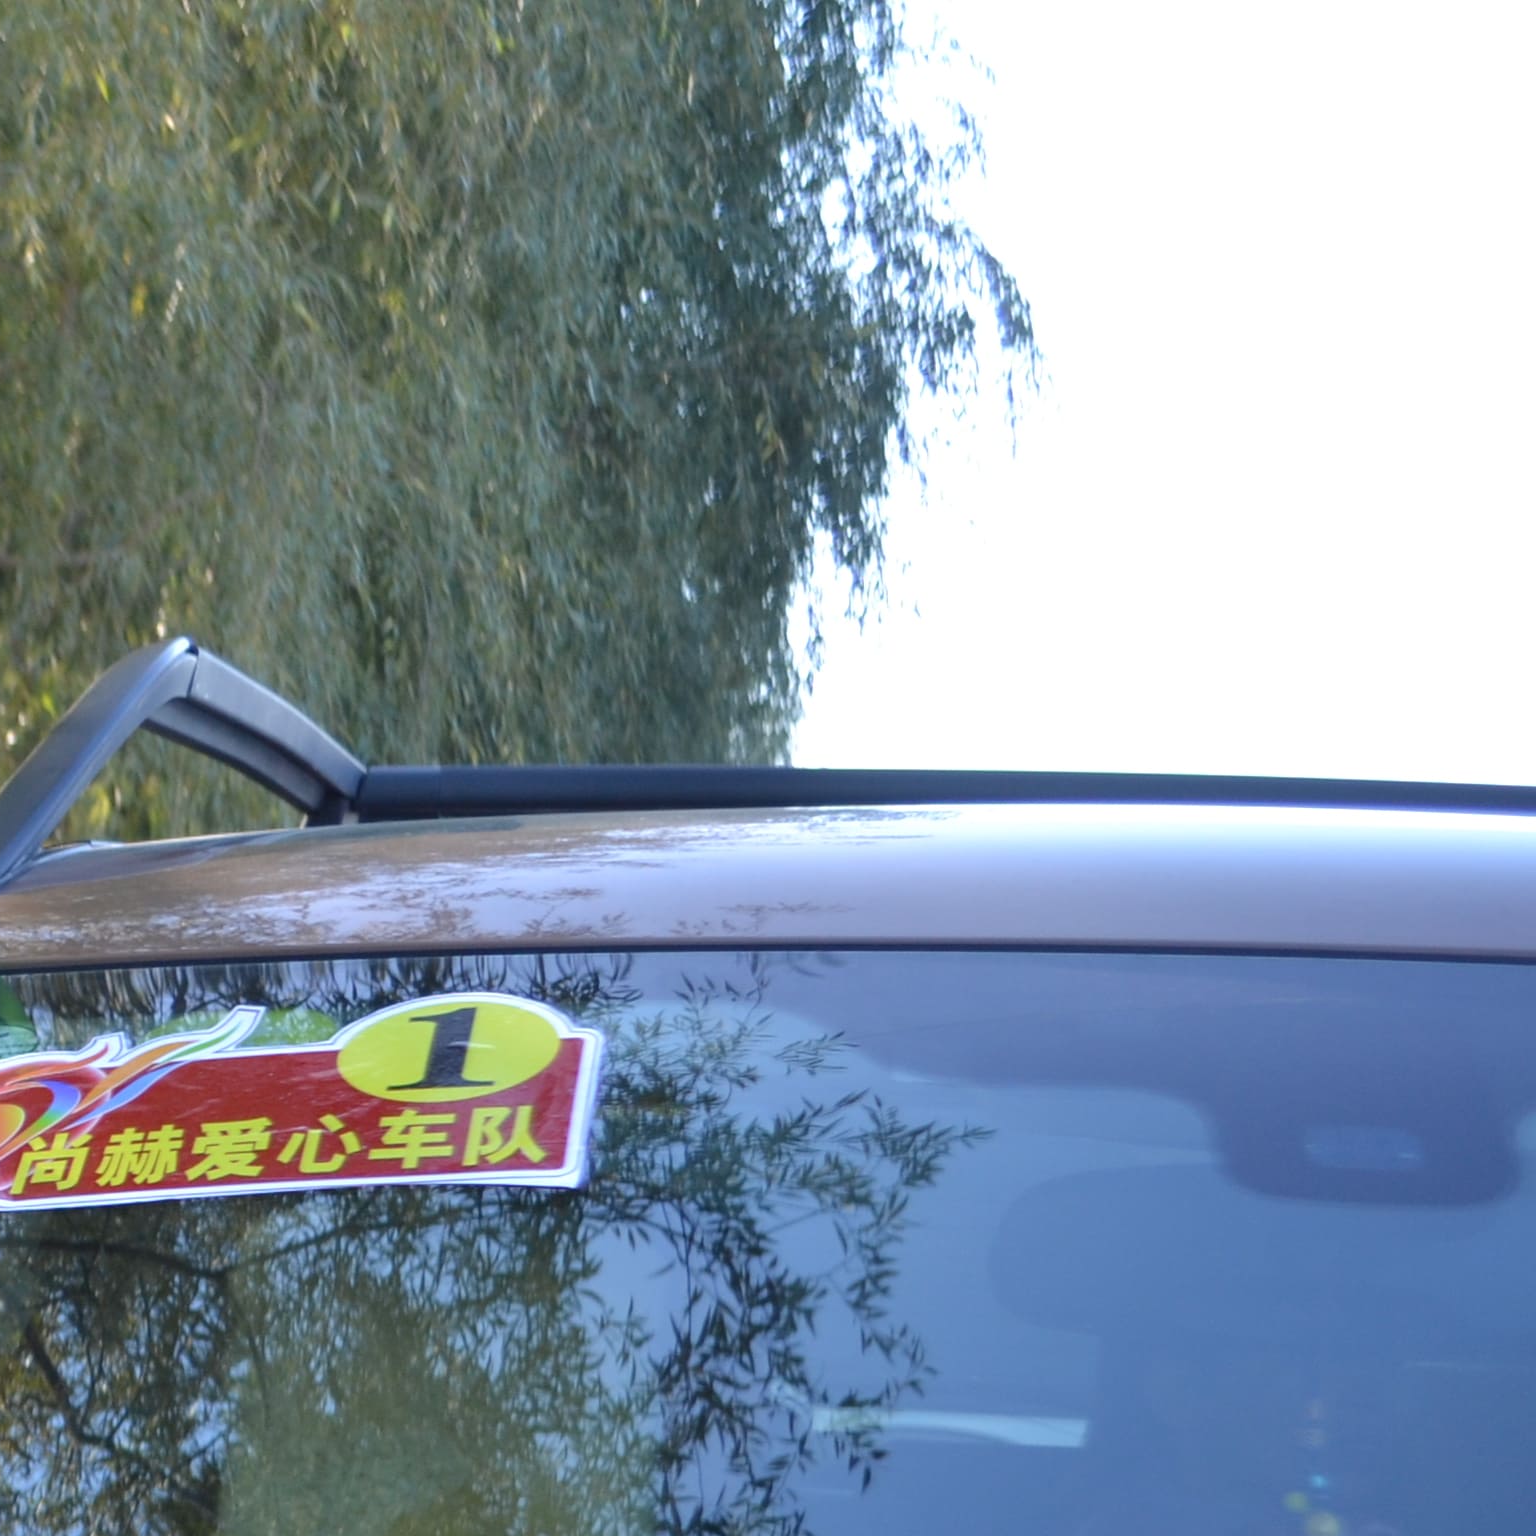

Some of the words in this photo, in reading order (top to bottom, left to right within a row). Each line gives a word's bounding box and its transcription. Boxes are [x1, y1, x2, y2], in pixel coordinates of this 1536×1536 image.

[385, 1007, 496, 1091] 1
[9, 1105, 549, 1195] 尚赫爱心车队
